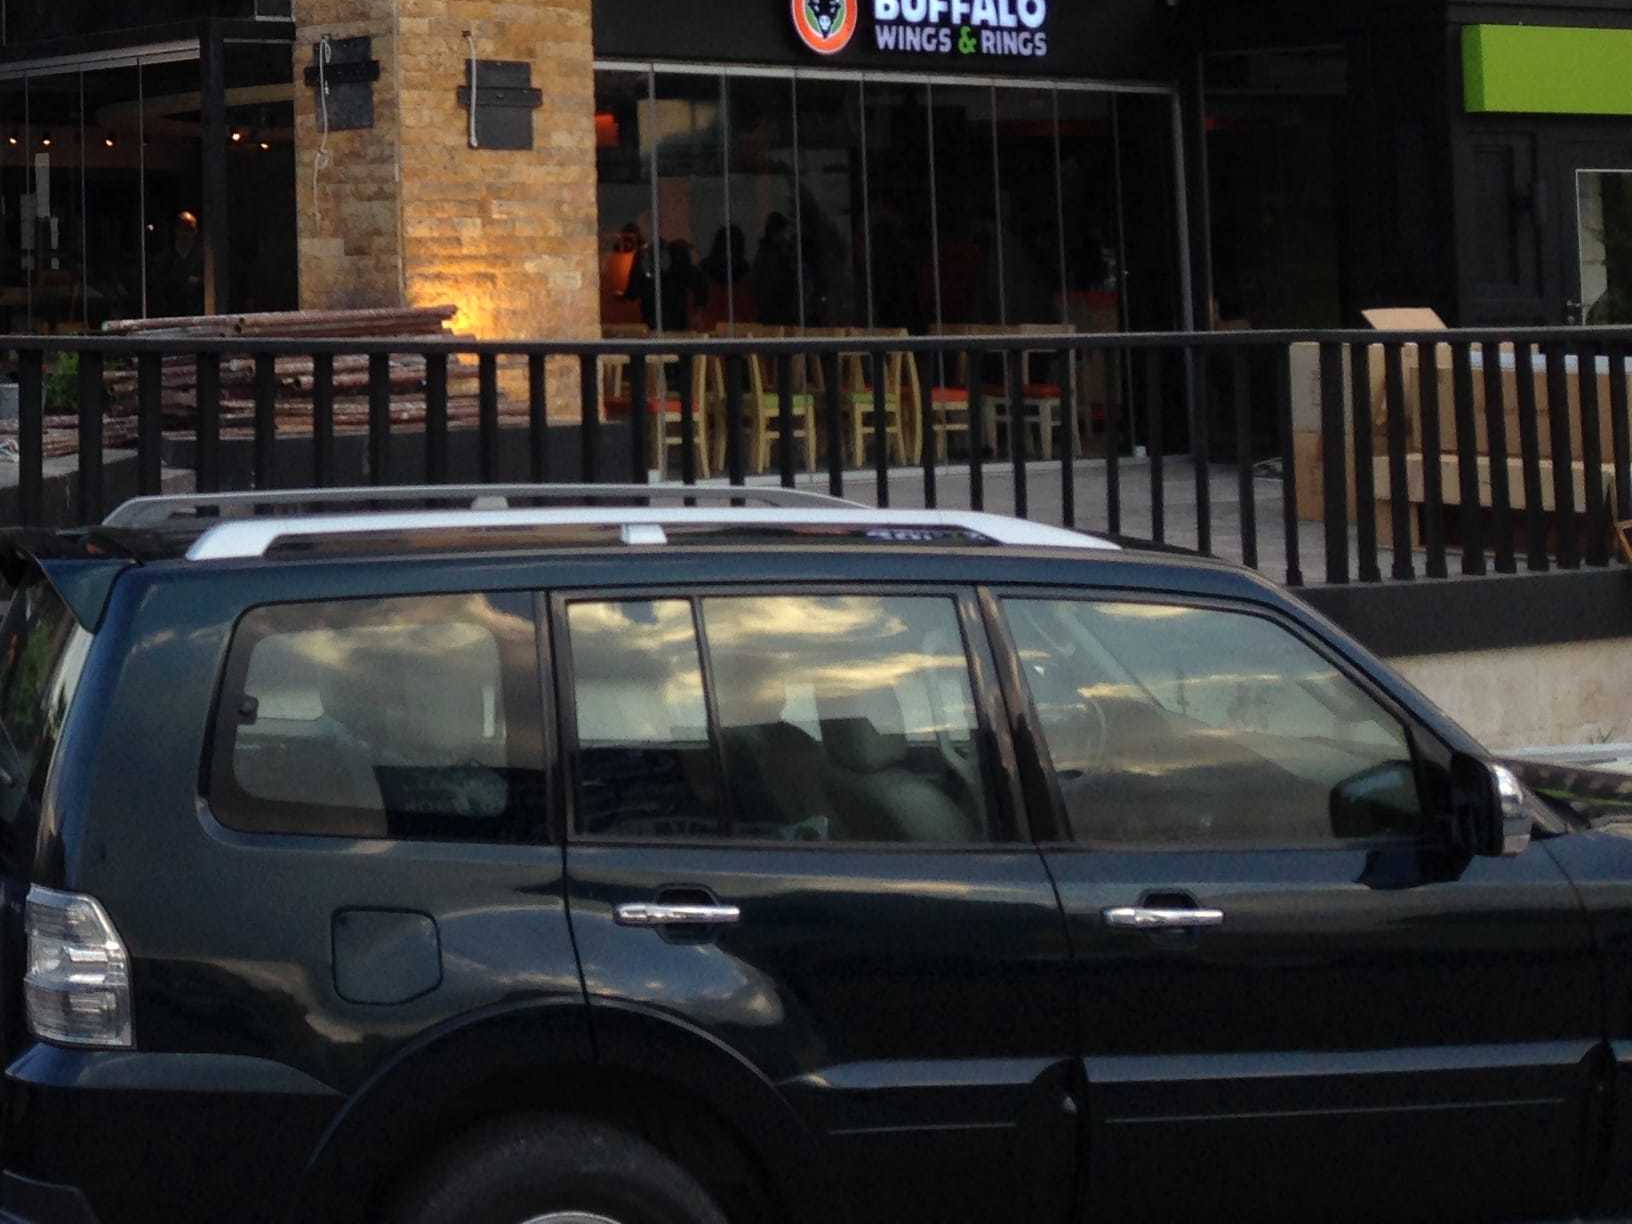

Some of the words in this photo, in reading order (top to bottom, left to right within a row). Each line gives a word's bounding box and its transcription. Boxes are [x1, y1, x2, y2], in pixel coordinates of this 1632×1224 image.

[875, 26, 952, 53] WINGS
[958, 26, 977, 55] &
[981, 30, 1047, 57] RINGS
